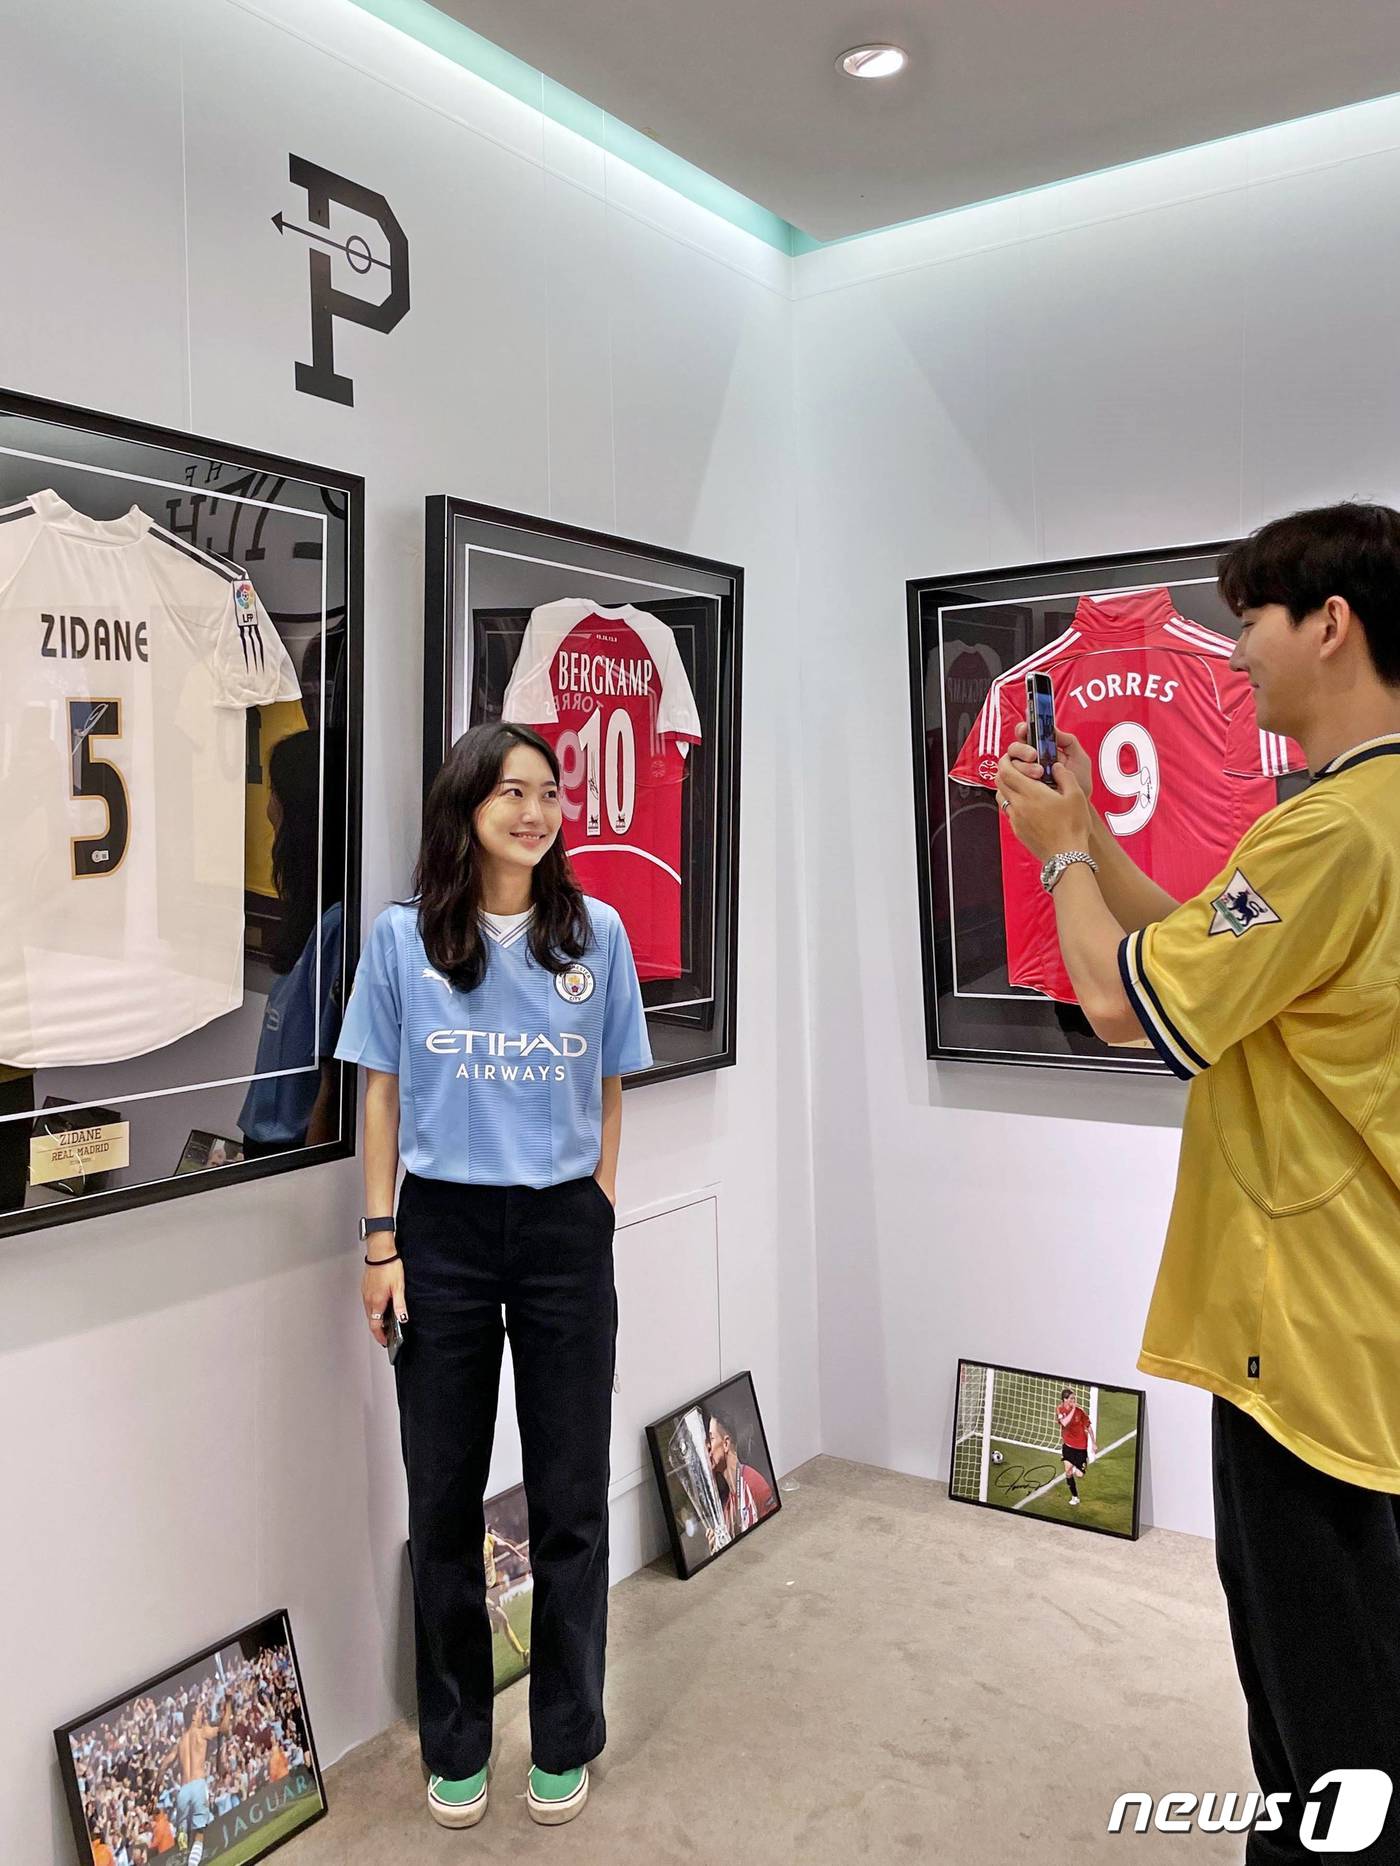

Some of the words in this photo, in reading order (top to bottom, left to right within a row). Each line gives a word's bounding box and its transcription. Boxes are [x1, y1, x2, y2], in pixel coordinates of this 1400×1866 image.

[289, 152, 410, 408] P
[41, 613, 148, 662] ZIDANE
[242, 613, 254, 623] LFP
[558, 650, 653, 697] BERGKAMP
[1069, 672, 1180, 709] TORRES
[65, 697, 132, 881] 5
[577, 708, 636, 836] 10
[1098, 721, 1161, 837] 9
[426, 1029, 588, 1057] ETIHAD
[456, 1063, 565, 1081] AIRWAYS
[51, 1149, 74, 1161] REAL
[77, 1143, 110, 1157] MADRID
[60, 1128, 102, 1146] ZIDANE
[221, 1775, 308, 1849] JAGUAR
